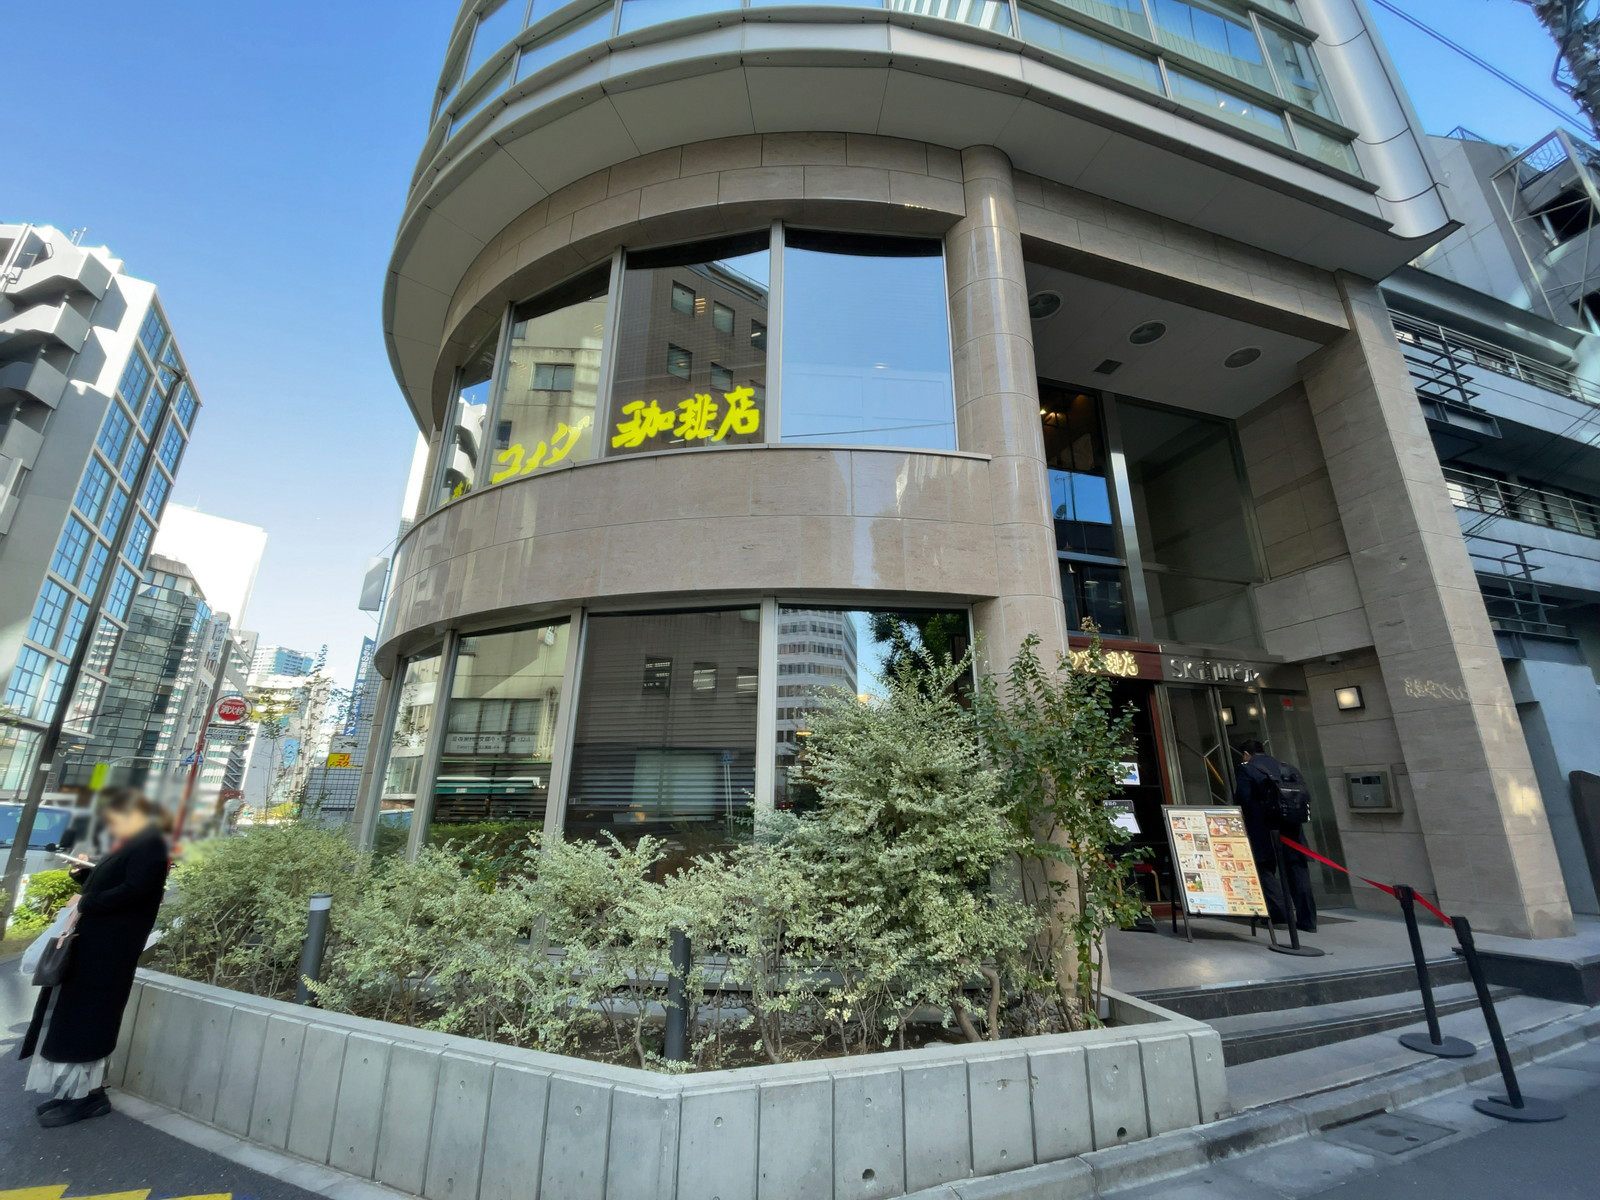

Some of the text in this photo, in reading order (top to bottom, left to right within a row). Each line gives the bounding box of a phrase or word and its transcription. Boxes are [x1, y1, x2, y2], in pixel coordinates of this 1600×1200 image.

[611, 386, 760, 448] 珈琲店
[220, 704, 245, 716] 消火栓
